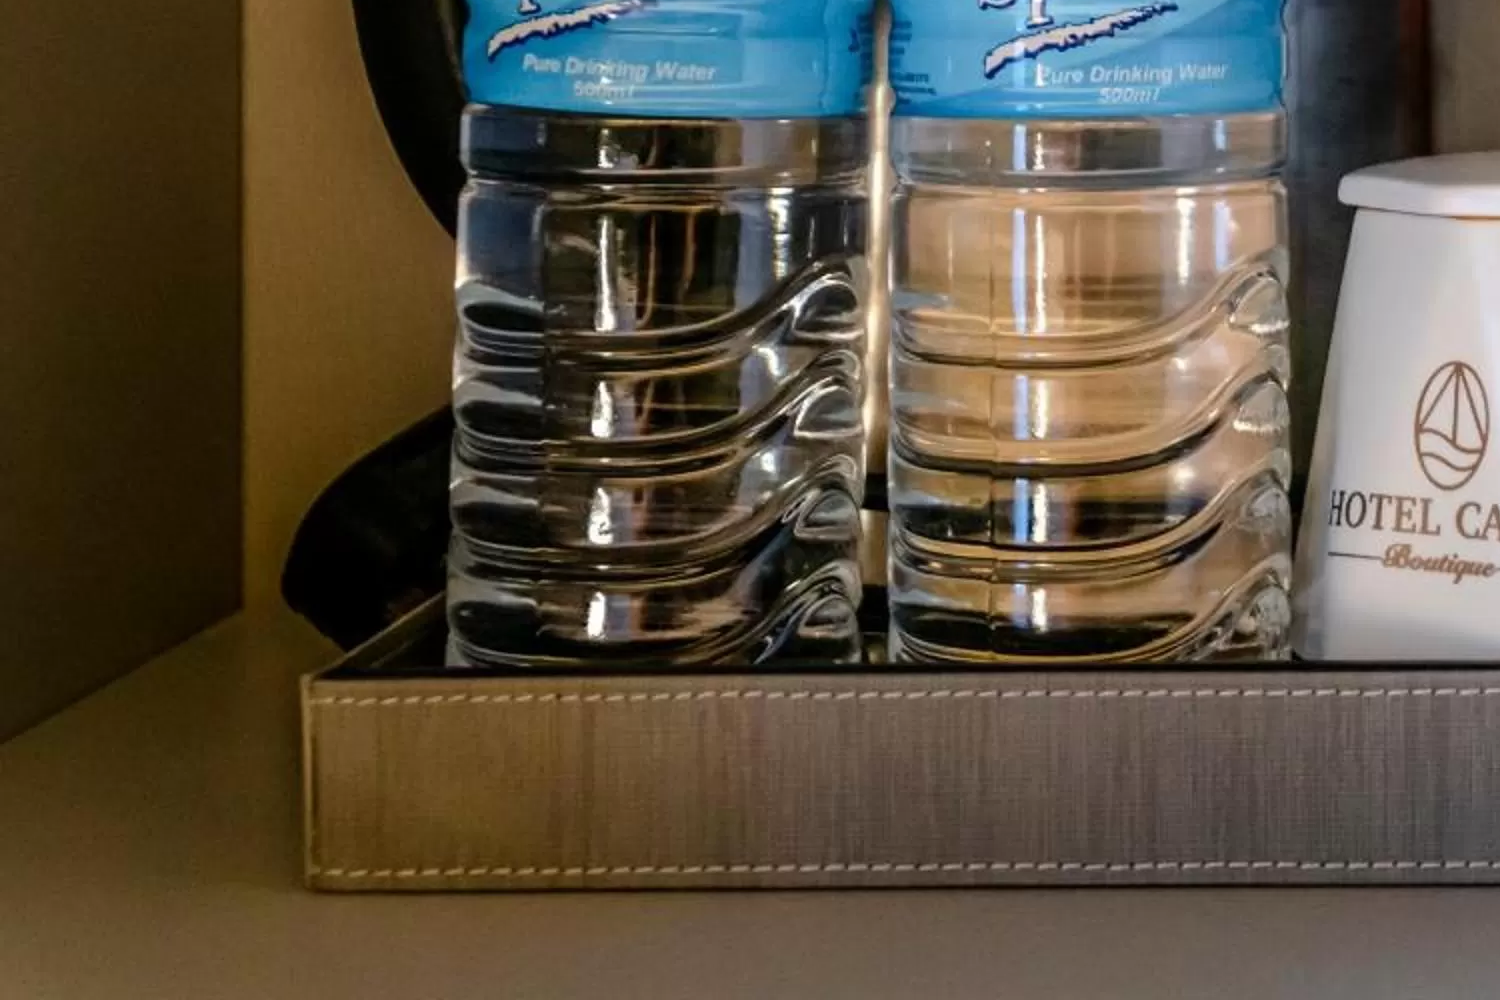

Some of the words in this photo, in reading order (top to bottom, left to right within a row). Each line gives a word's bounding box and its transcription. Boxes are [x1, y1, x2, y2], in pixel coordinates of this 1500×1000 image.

[523, 53, 561, 74] Pure
[565, 56, 649, 82] Drinking
[655, 60, 719, 81] Water
[1035, 63, 1084, 87] Pure
[1090, 64, 1174, 85] Drinking
[1179, 63, 1228, 81] Water
[1327, 490, 1441, 536] HOTEL
[1381, 543, 1497, 584] Boutique
